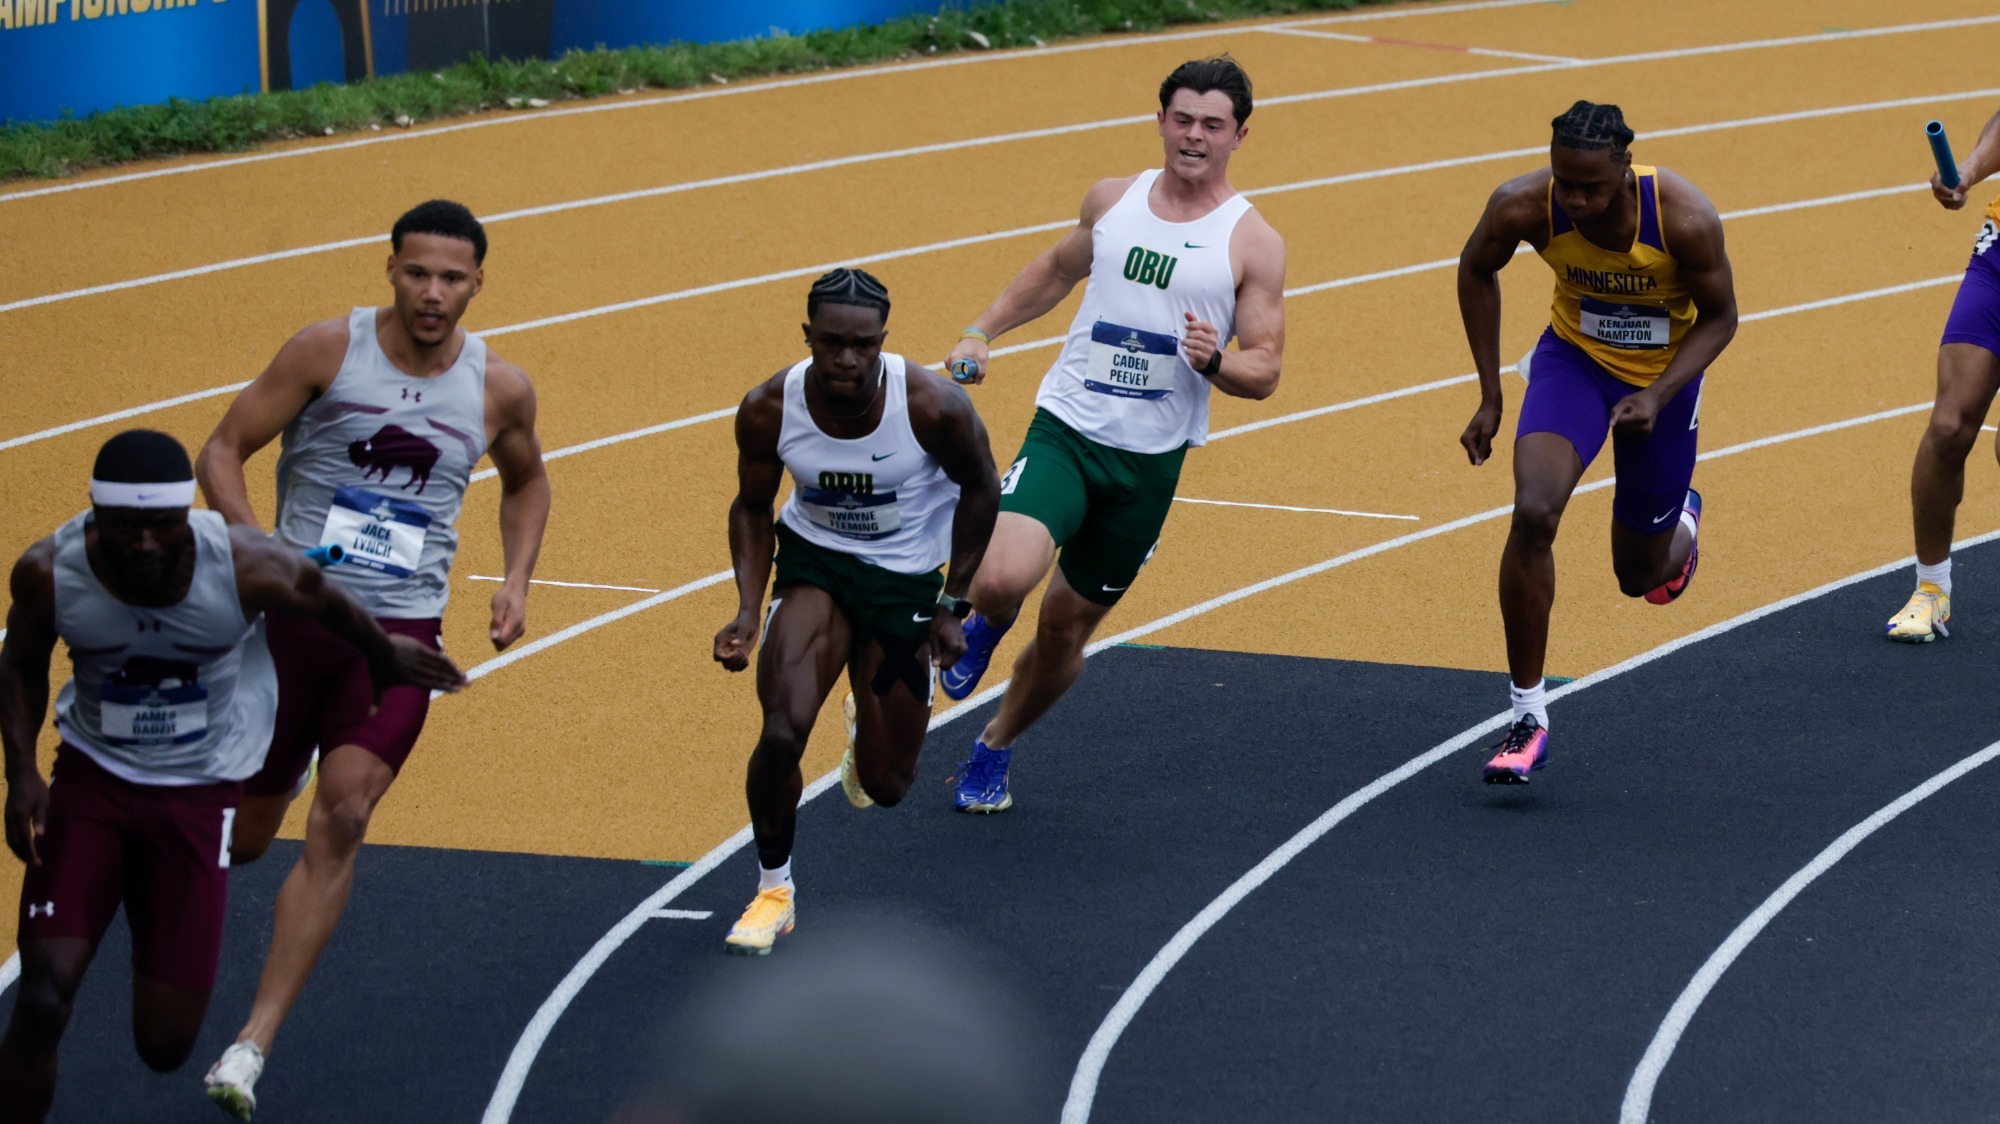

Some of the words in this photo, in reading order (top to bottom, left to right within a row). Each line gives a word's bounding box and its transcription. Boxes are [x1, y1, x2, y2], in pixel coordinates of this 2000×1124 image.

[1123, 245, 1178, 290] OBU
[1566, 264, 1658, 294] MINNESOTA
[1599, 319, 1650, 329] KENJUAN
[1597, 328, 1652, 341] HAMPTON
[1113, 353, 1150, 371] CADEN
[1109, 368, 1150, 387] PEEVEY
[353, 536, 393, 558] LYNCH
